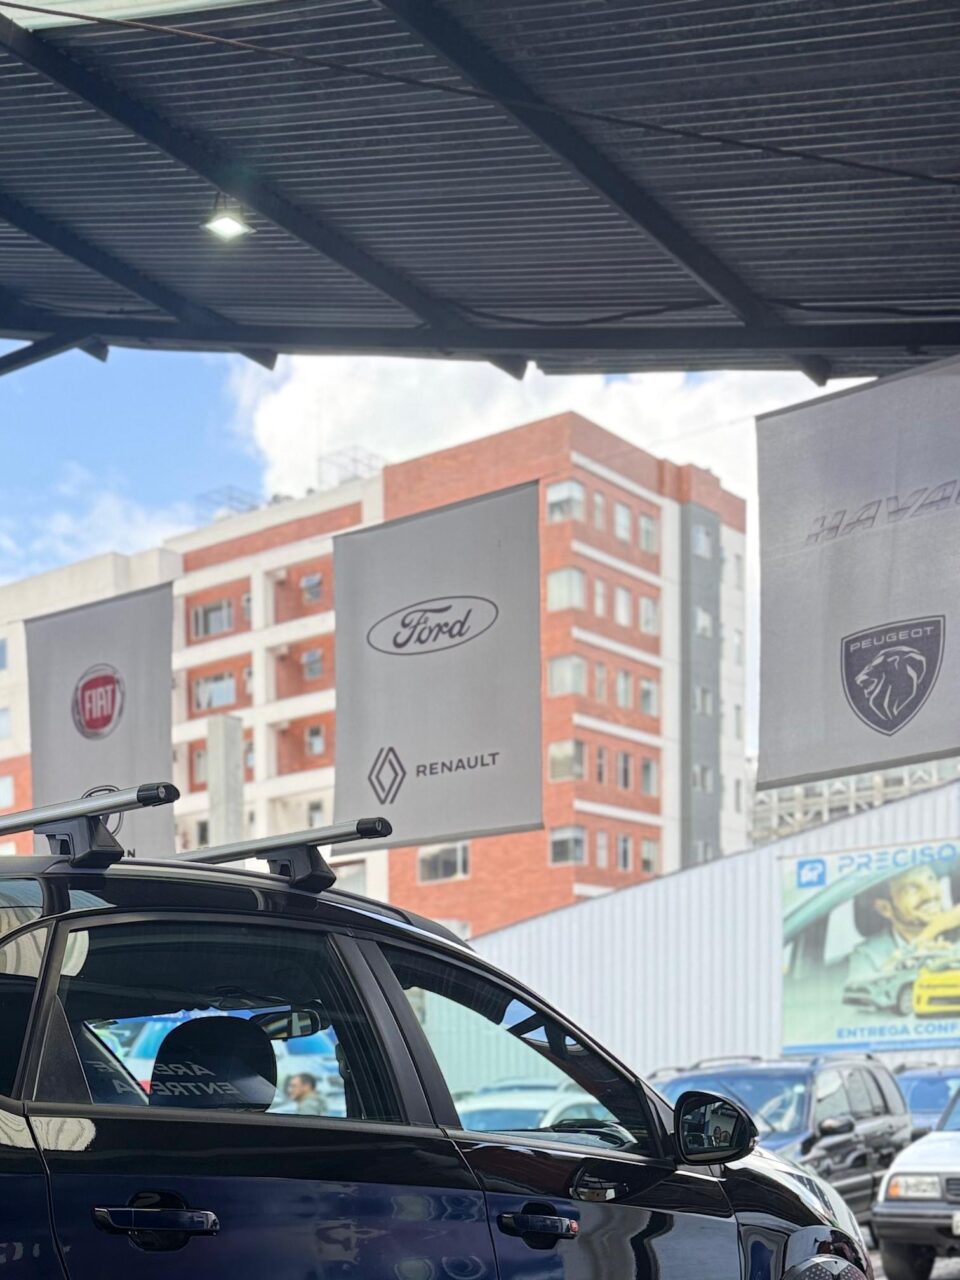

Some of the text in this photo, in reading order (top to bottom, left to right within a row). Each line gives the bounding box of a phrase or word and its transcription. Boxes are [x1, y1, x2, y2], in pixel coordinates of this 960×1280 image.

[804, 478, 960, 547] HAVA
[392, 604, 473, 649] Ford
[849, 626, 935, 652] PEUGEOT
[83, 684, 114, 720] FIAT
[415, 751, 500, 778] RENAULT
[837, 843, 959, 873] PRECISO
[836, 1022, 911, 1039] ENTREGA
